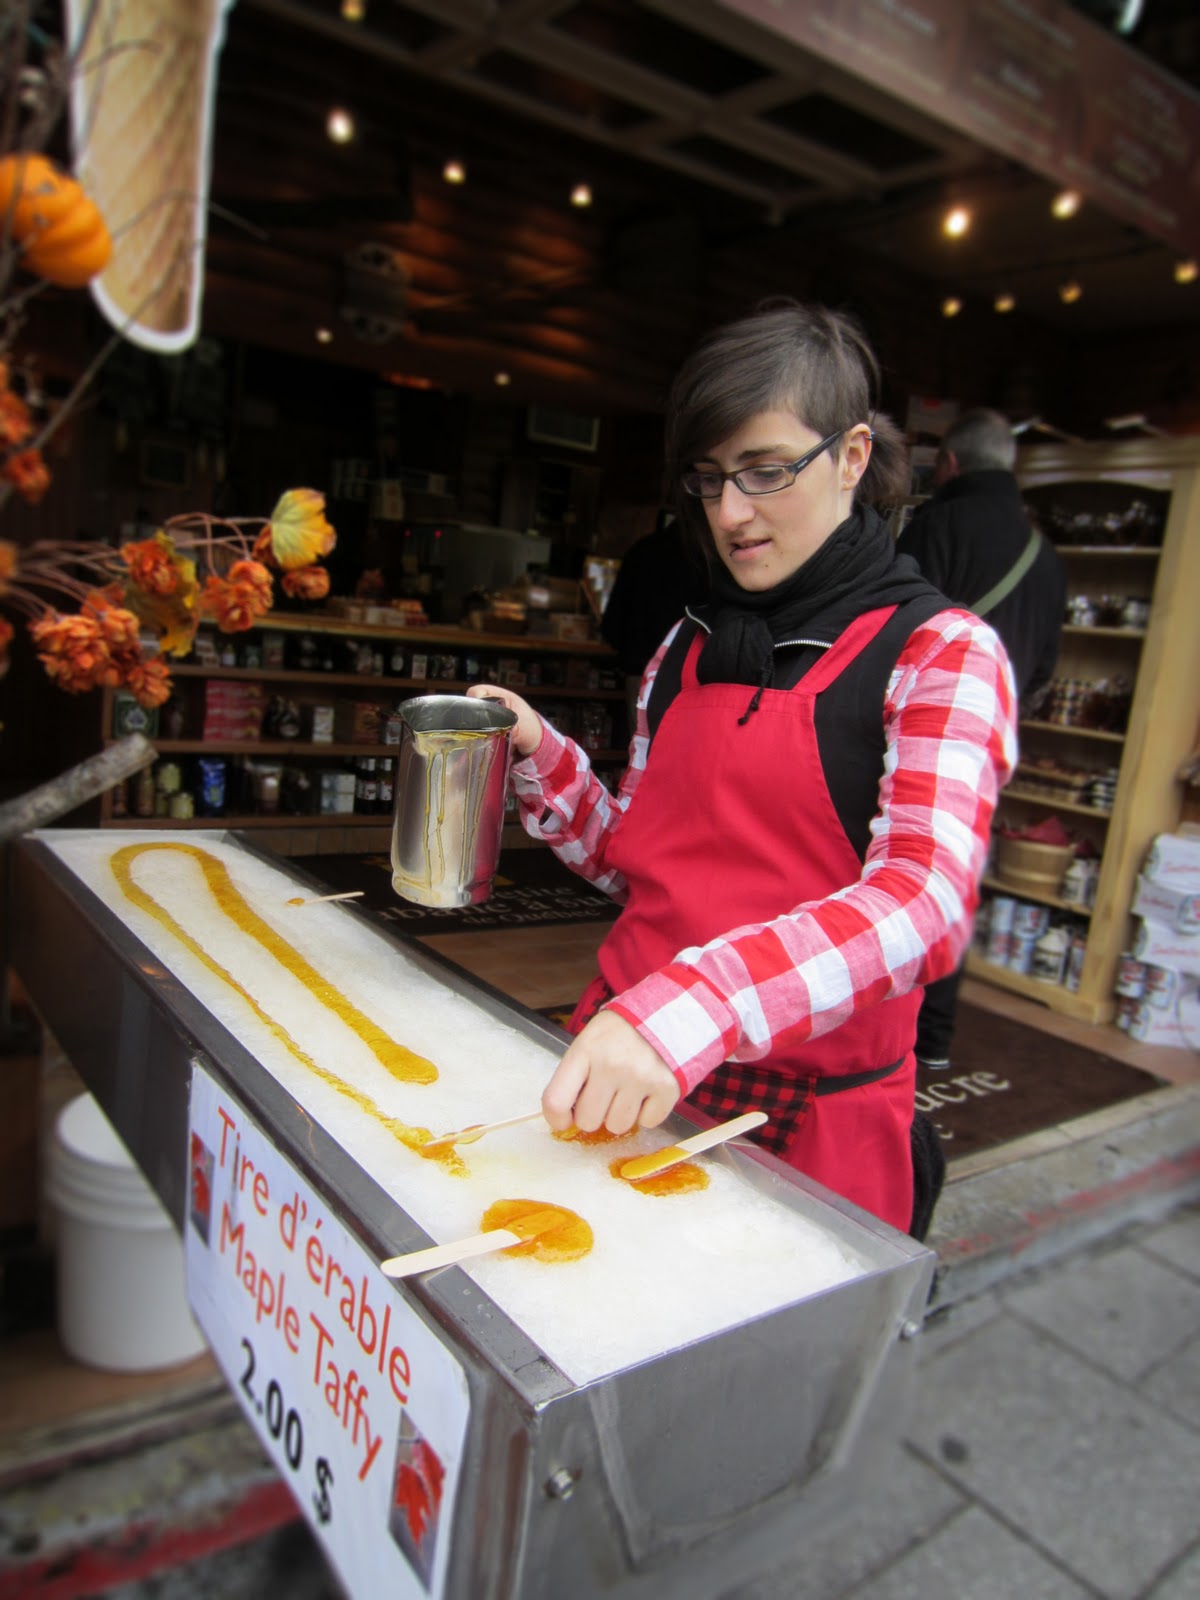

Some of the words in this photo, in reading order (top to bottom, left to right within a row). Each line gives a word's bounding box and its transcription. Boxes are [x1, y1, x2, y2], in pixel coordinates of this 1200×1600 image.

[377, 902, 513, 920] bane
[914, 1071, 1010, 1111] ucre
[218, 1105, 270, 1216] Tire
[279, 1191, 411, 1405] d'érable
[220, 1202, 300, 1354] Maple
[309, 1311, 383, 1482] Taffy
[240, 1336, 304, 1471] 2.00
